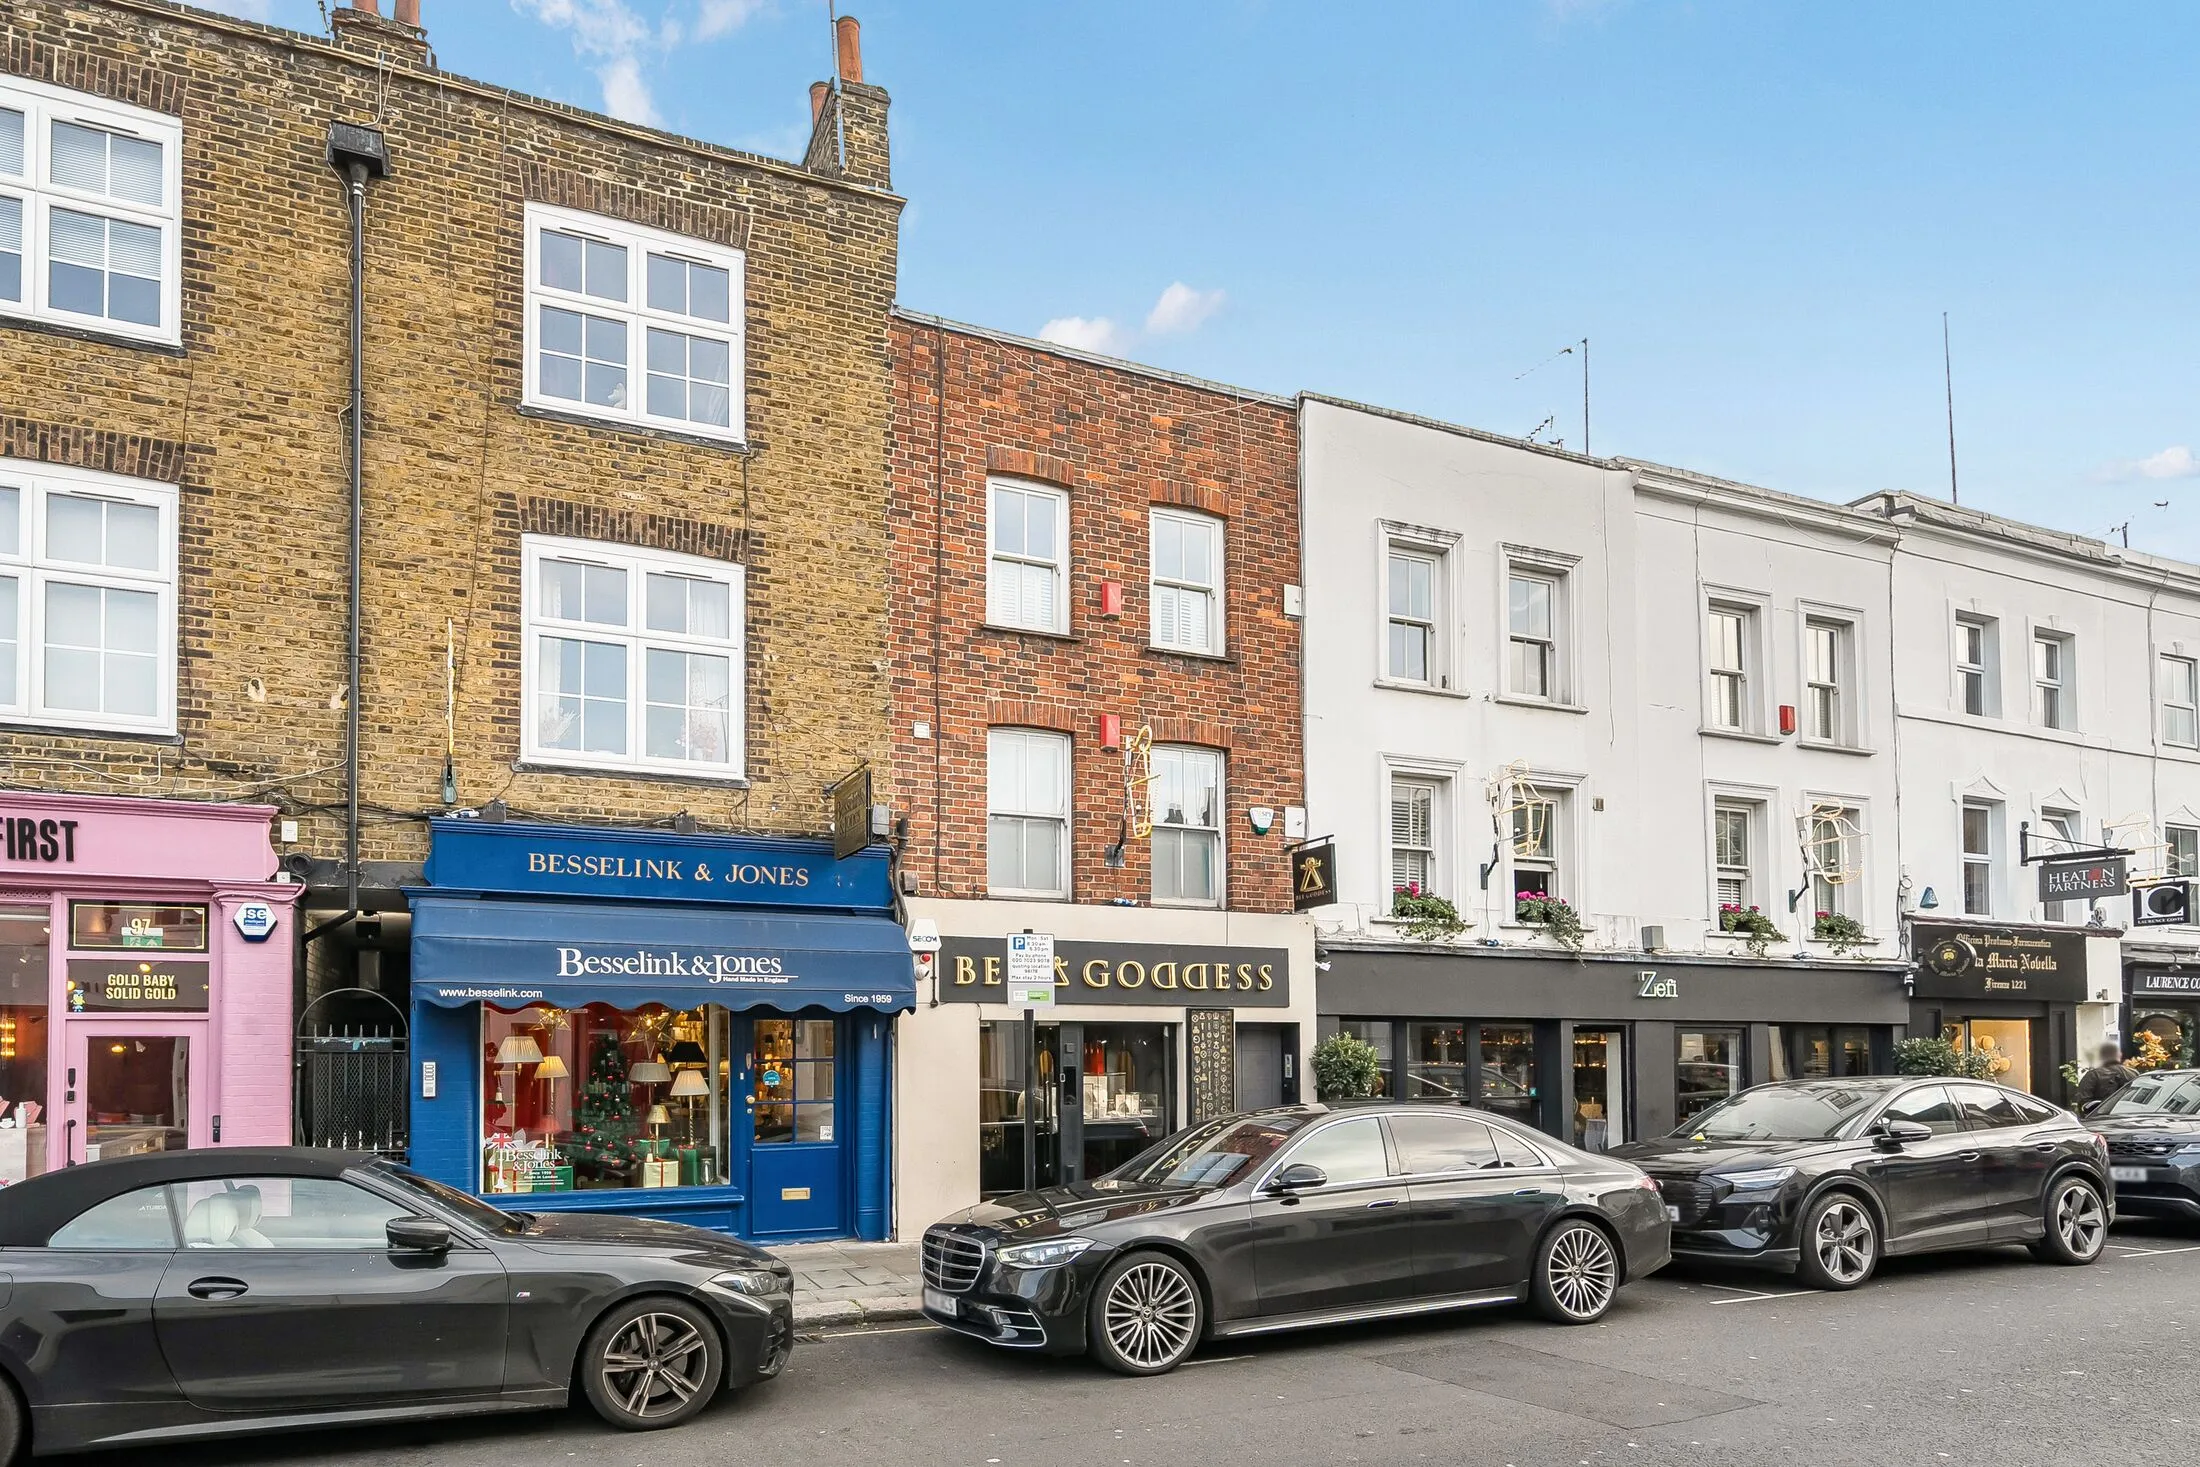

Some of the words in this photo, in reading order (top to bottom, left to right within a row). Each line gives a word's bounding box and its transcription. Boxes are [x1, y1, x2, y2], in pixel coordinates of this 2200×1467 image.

[0, 817, 78, 862] IRST
[528, 853, 683, 880] BESSELINK
[694, 863, 713, 882] &
[725, 864, 809, 887] JONES
[2049, 878, 2115, 893] PARTNERS
[131, 918, 151, 935] 97
[1015, 938, 1024, 949] P
[556, 947, 691, 977] Besselink
[708, 954, 782, 984] Jones
[1986, 952, 2018, 972] Maria
[2020, 953, 2057, 974] Novella
[107, 974, 140, 986] GOLD
[143, 974, 175, 986] BABY
[954, 955, 1001, 985] BE
[1081, 959, 1274, 991] GODDESS
[1640, 970, 1679, 998] Zefi
[2011, 980, 2027, 989] 1221
[2146, 976, 2189, 989] LAURENCE
[105, 987, 141, 999] SOLID
[144, 988, 176, 1000] GOLD
[439, 988, 543, 998] www.besselink.com
[844, 994, 869, 1003] Since
[871, 994, 892, 1003] 1959
